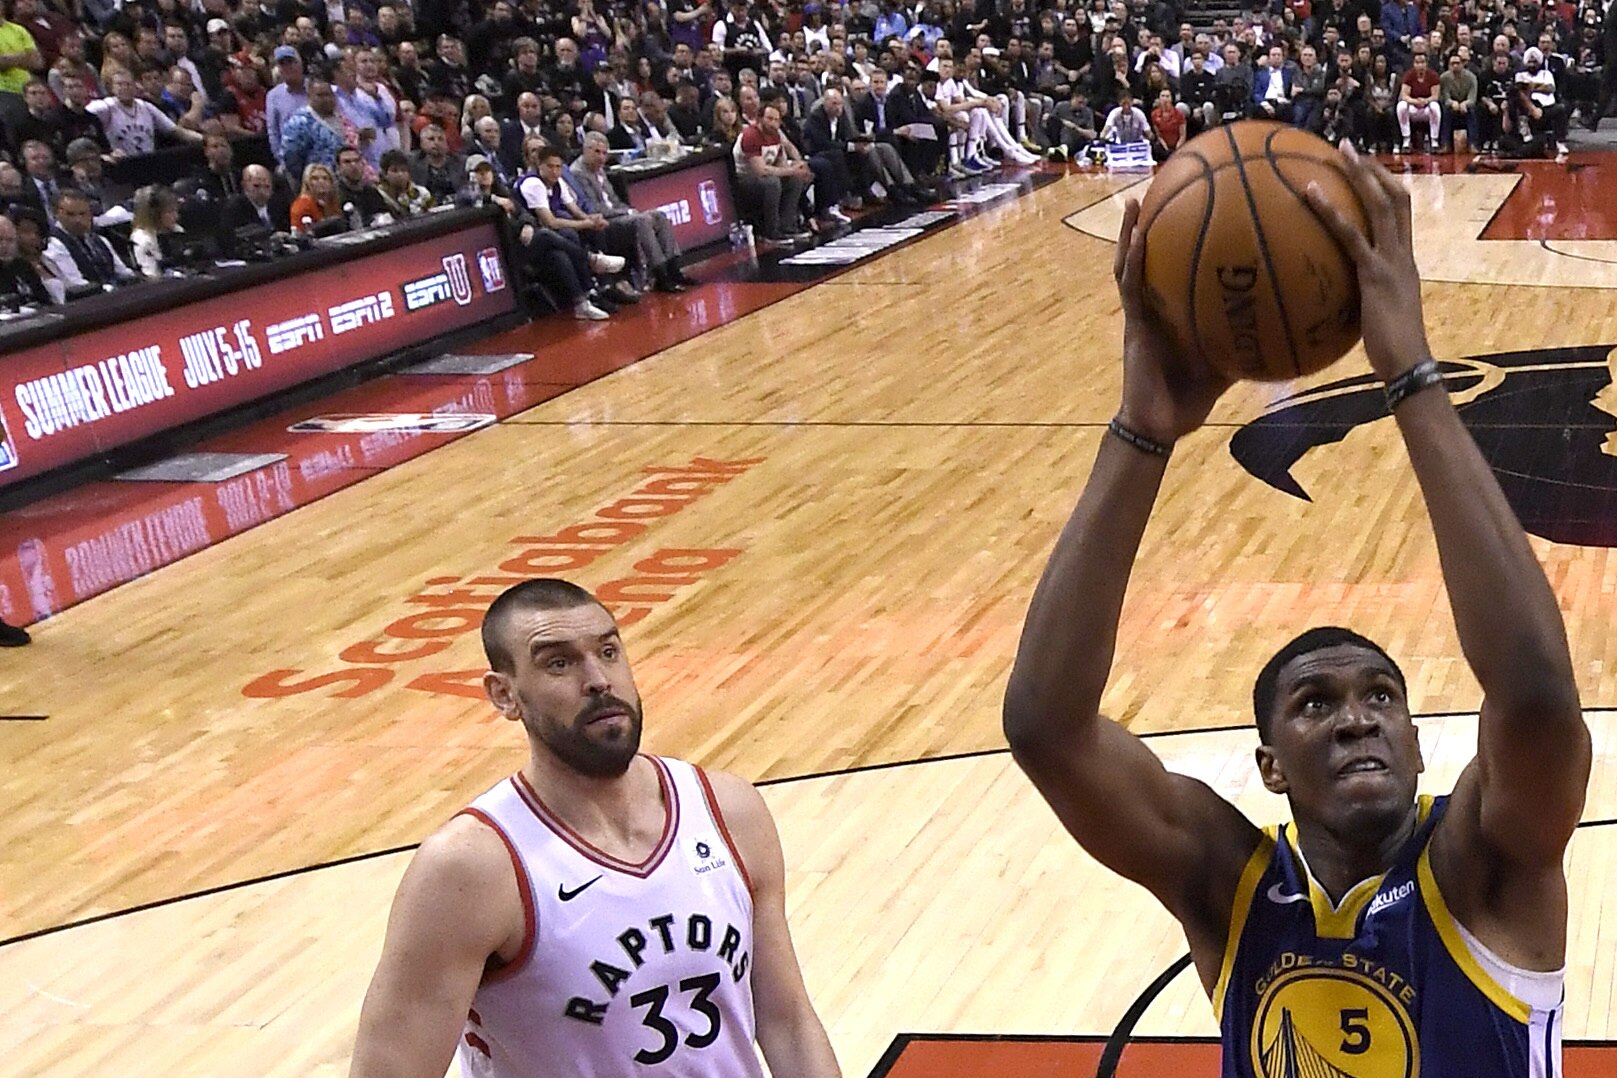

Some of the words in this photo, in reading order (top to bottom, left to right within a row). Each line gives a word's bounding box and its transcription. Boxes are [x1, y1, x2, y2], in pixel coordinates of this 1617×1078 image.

[15, 365, 111, 439] SUMMER
[98, 345, 175, 413] LEAGUE
[179, 330, 225, 388] JULY
[213, 319, 262, 375] 5-15
[266, 313, 324, 354] ESPN
[241, 456, 768, 698] Scotiabank
[563, 913, 750, 1026] RAPTORS
[1342, 953, 1416, 1005] STATE
[630, 972, 721, 1065] 33
[1339, 1007, 1371, 1055] 5
